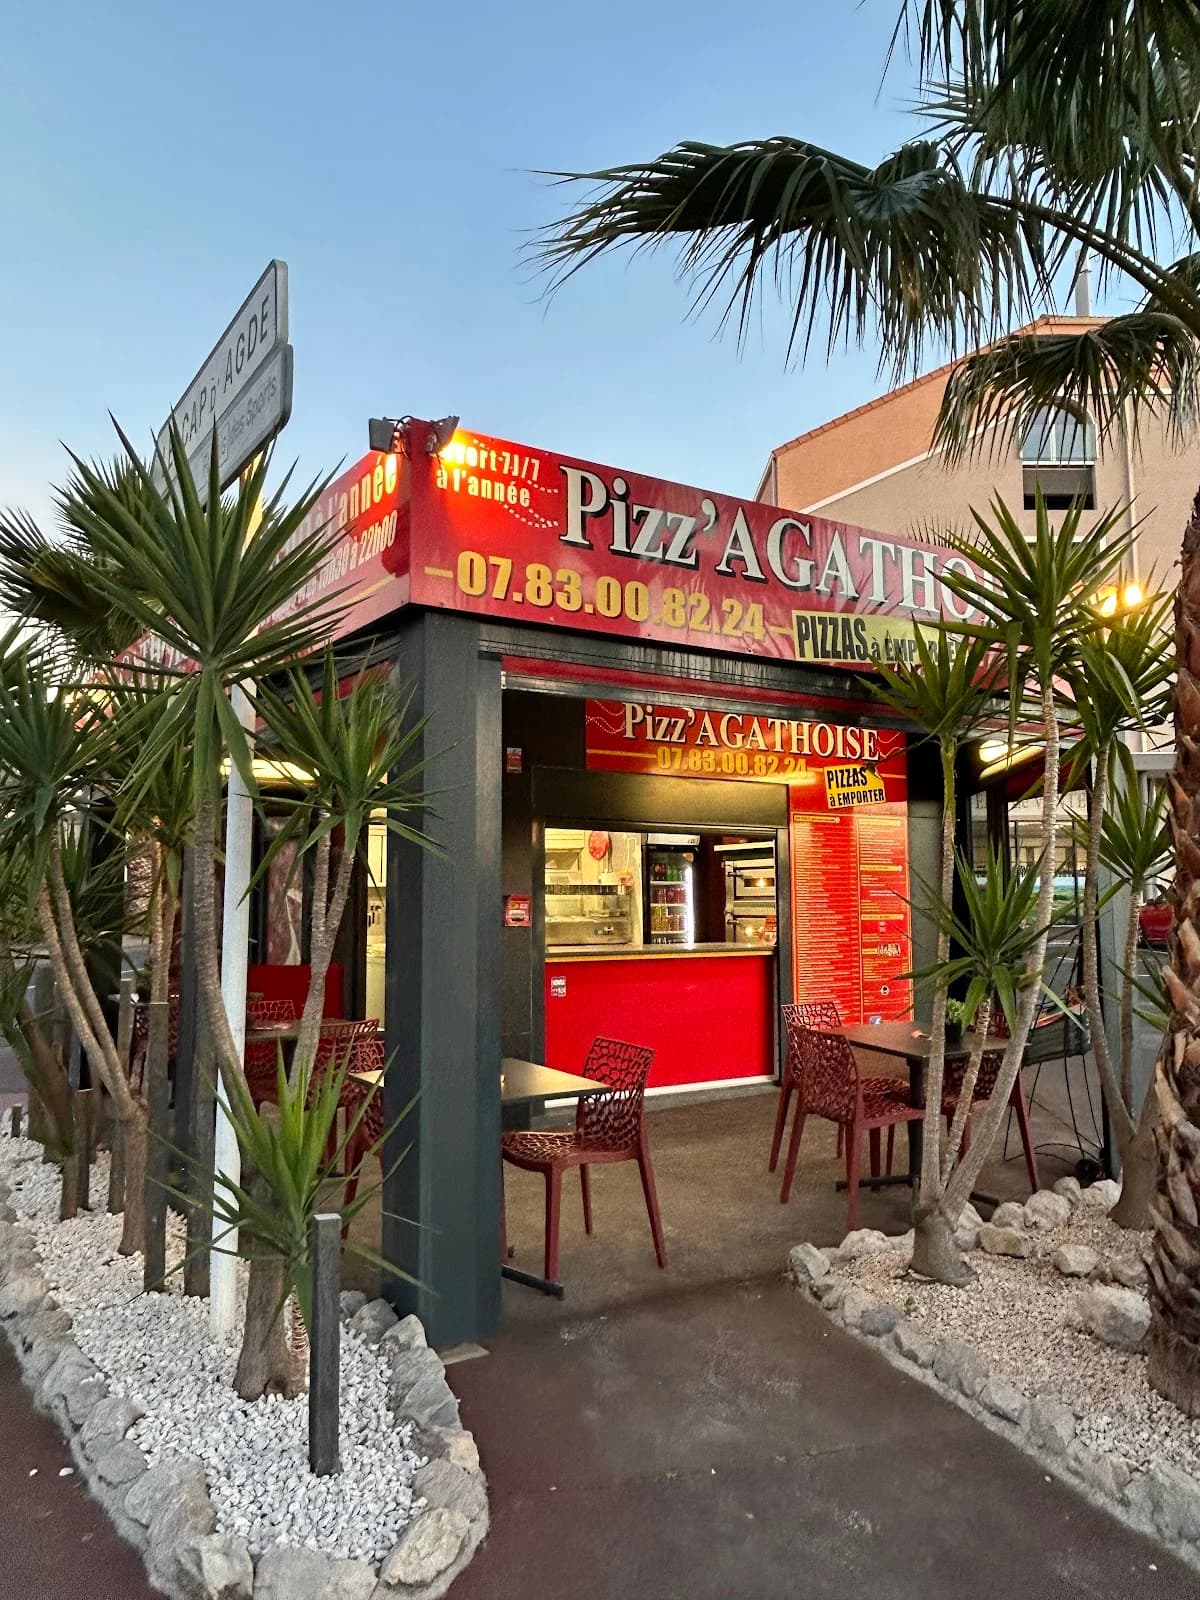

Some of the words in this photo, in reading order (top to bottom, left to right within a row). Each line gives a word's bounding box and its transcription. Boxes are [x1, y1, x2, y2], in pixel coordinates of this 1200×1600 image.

[181, 386, 207, 449] CAP
[453, 468, 530, 507] l'année
[358, 510, 398, 566] 22h00
[457, 550, 766, 641] 07.83.00.82.24
[796, 614, 869, 661] PIZZAS
[871, 635, 881, 661] à
[623, 702, 880, 761] Pizz'AGATHOISE
[657, 745, 807, 779] 07.83.00.82.24
[826, 768, 868, 790] PIZZAS
[829, 794, 836, 807] à
[837, 788, 885, 806] EMPORTER
